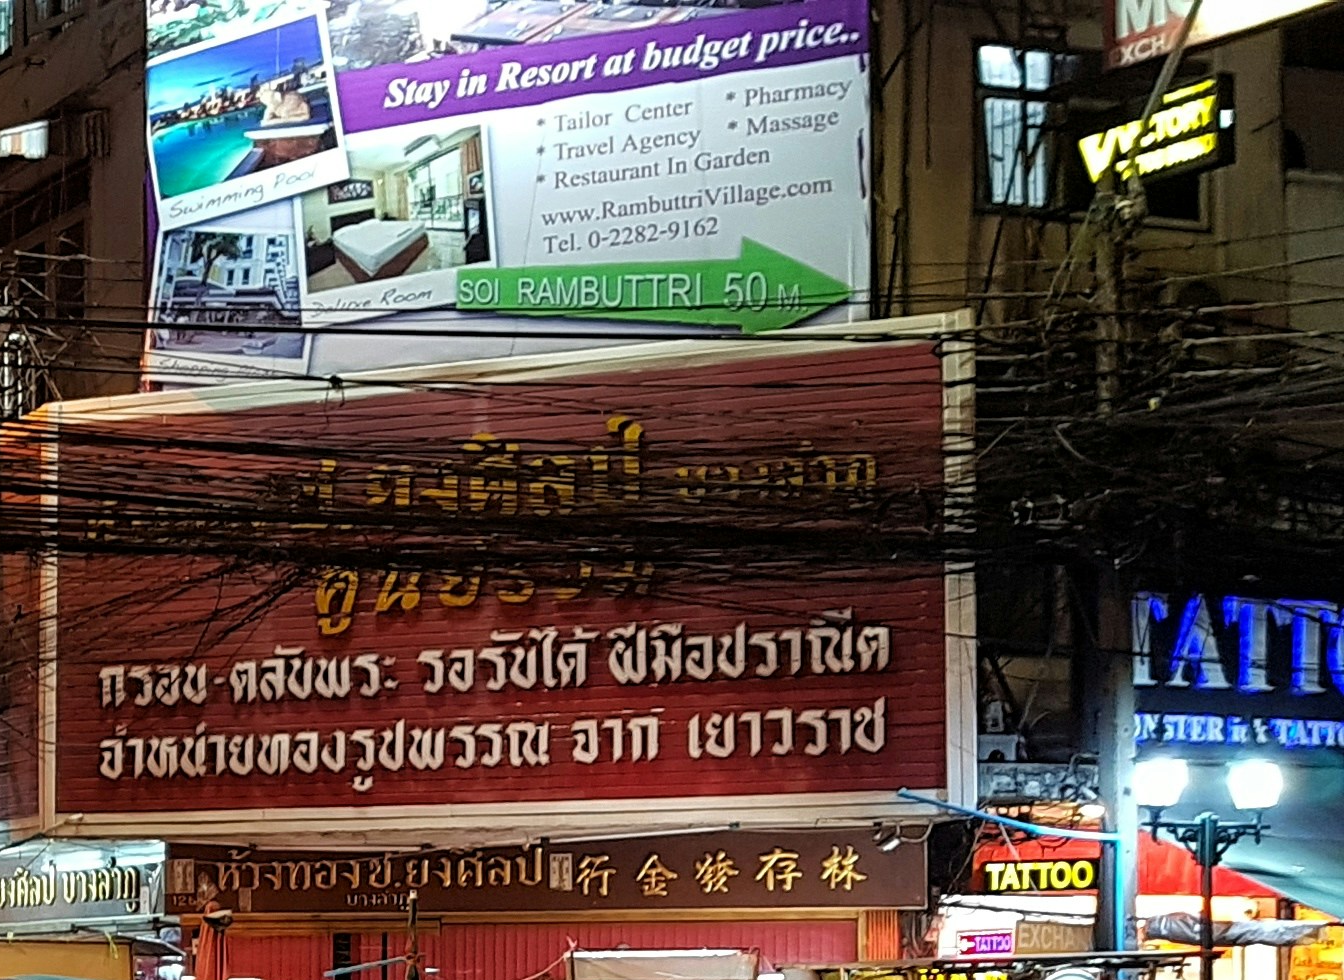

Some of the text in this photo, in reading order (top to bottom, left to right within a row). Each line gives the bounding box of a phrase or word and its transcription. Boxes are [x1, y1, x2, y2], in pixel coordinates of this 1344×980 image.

[384, 70, 450, 110] Stay
[457, 69, 489, 96] in
[495, 53, 600, 92] Resort
[603, 50, 633, 76] at
[640, 34, 753, 72] budget
[744, 78, 853, 107] Pharmacy
[554, 99, 693, 134] Tailor Center
[746, 108, 840, 137] Massage
[553, 128, 702, 162] Travel Agency
[553, 147, 771, 190] Restaurant In Garden
[168, 168, 317, 219] Swimming Pool
[541, 177, 834, 226] www.RambuttriVillage.com
[543, 216, 720, 254] Tel. 0-2282-9162
[379, 288, 433, 305] Room
[458, 278, 501, 304] SOI
[516, 272, 704, 308] RAMBUTTRI
[723, 272, 769, 312] 50
[416, 624, 600, 693] รอรับได้
[98, 696, 887, 791] จำหน่ายทองรูปพรรณ จาก เยาวราช
[985, 860, 1094, 891] TATTOO
[974, 934, 1012, 953] TATTOO
